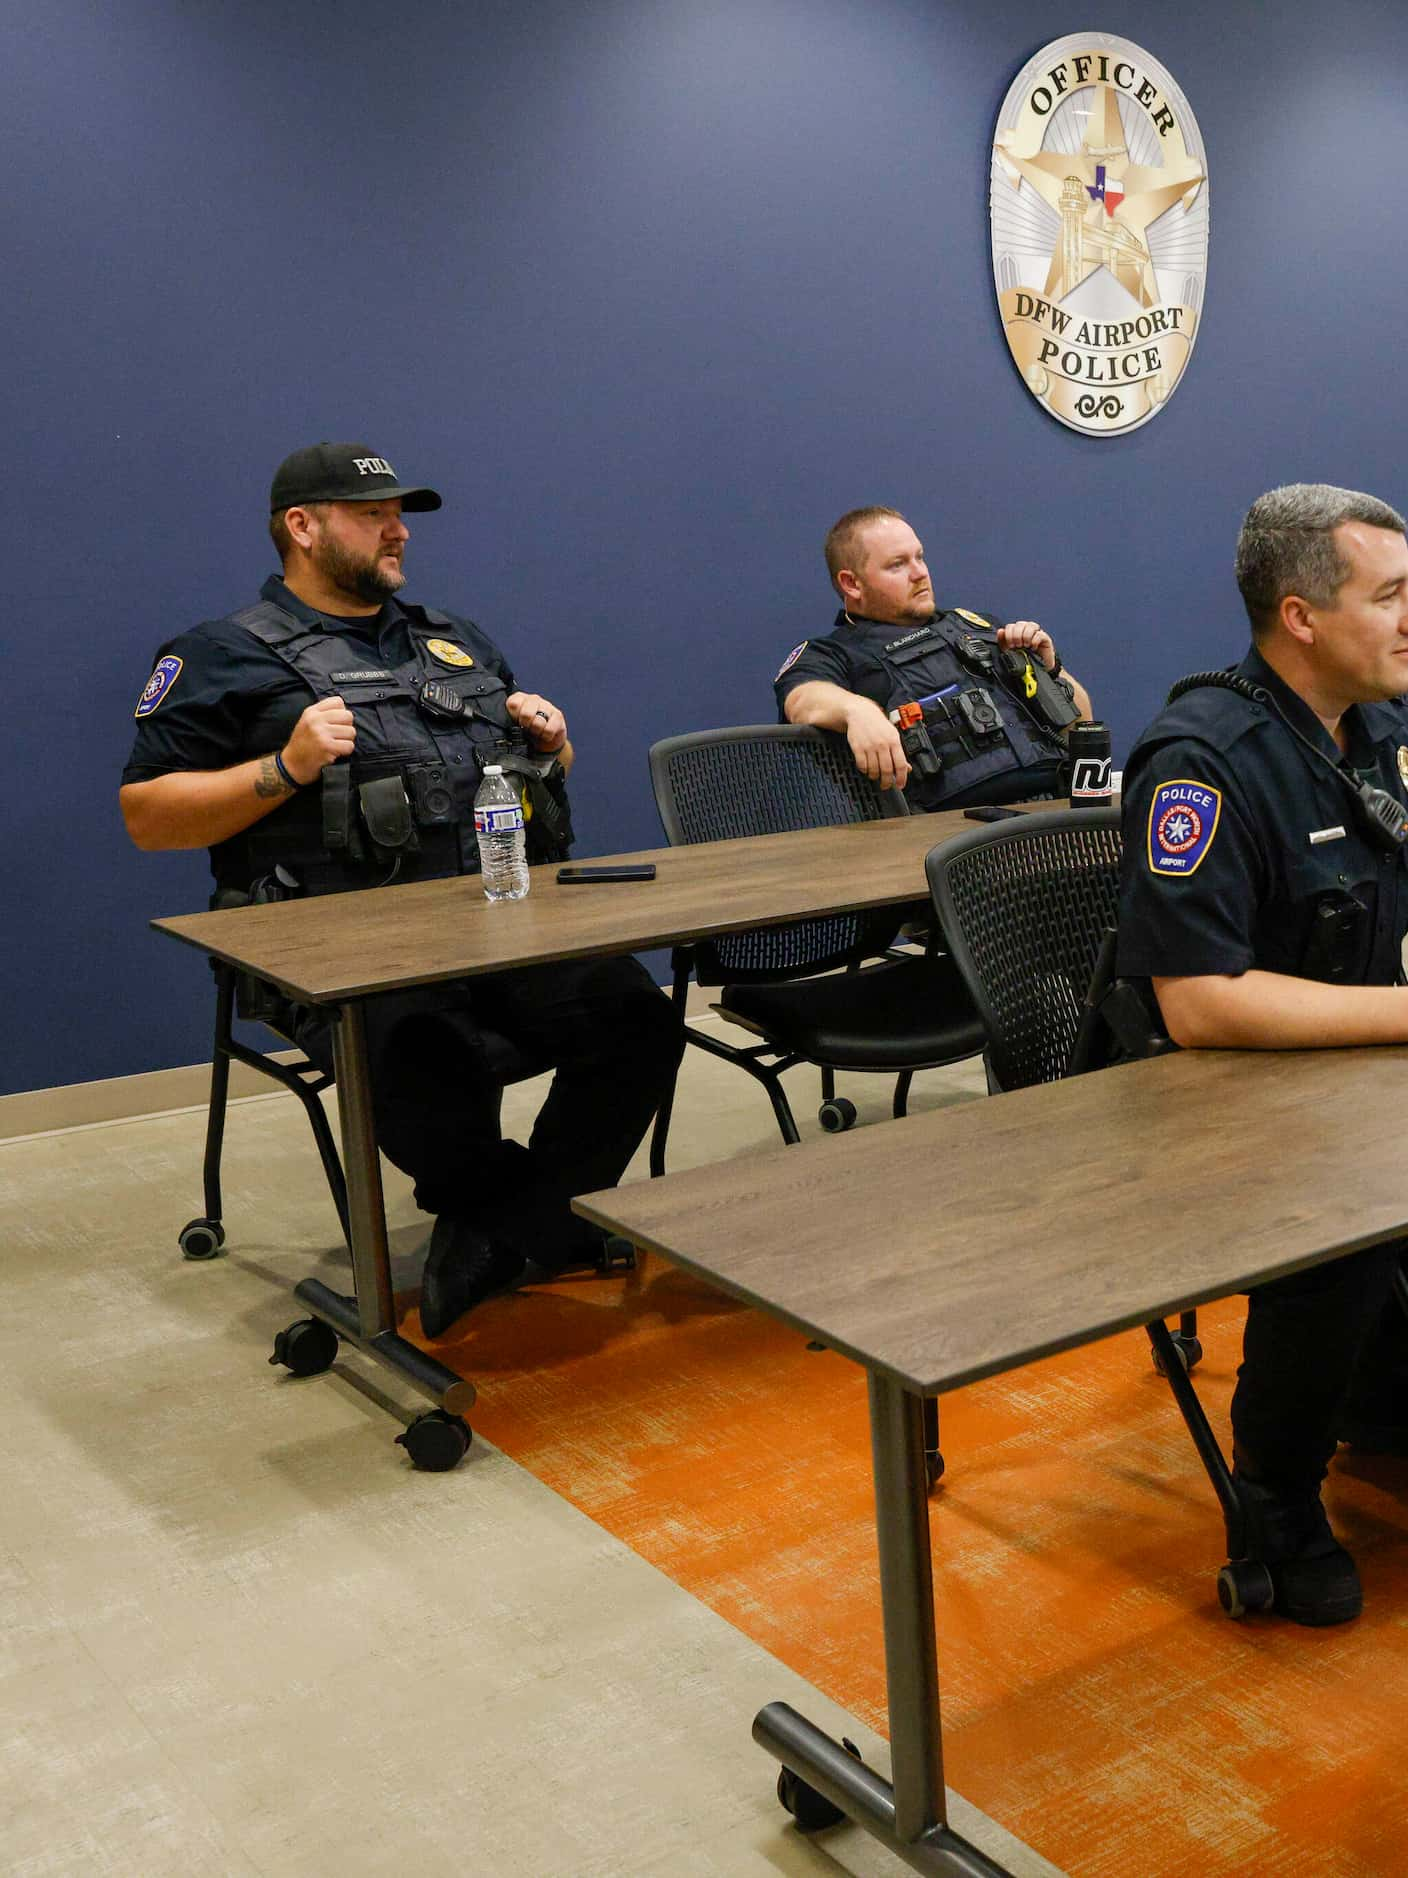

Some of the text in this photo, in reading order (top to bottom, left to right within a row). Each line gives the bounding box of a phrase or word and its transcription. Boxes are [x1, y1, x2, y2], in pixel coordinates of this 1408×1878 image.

[1030, 55, 1175, 137] OFFICER
[1014, 292, 1184, 348] DFW AIRPORT
[1037, 337, 1163, 381] POLICE
[1161, 788, 1213, 808] POLICE
[1159, 857, 1187, 867] AIRPORT
